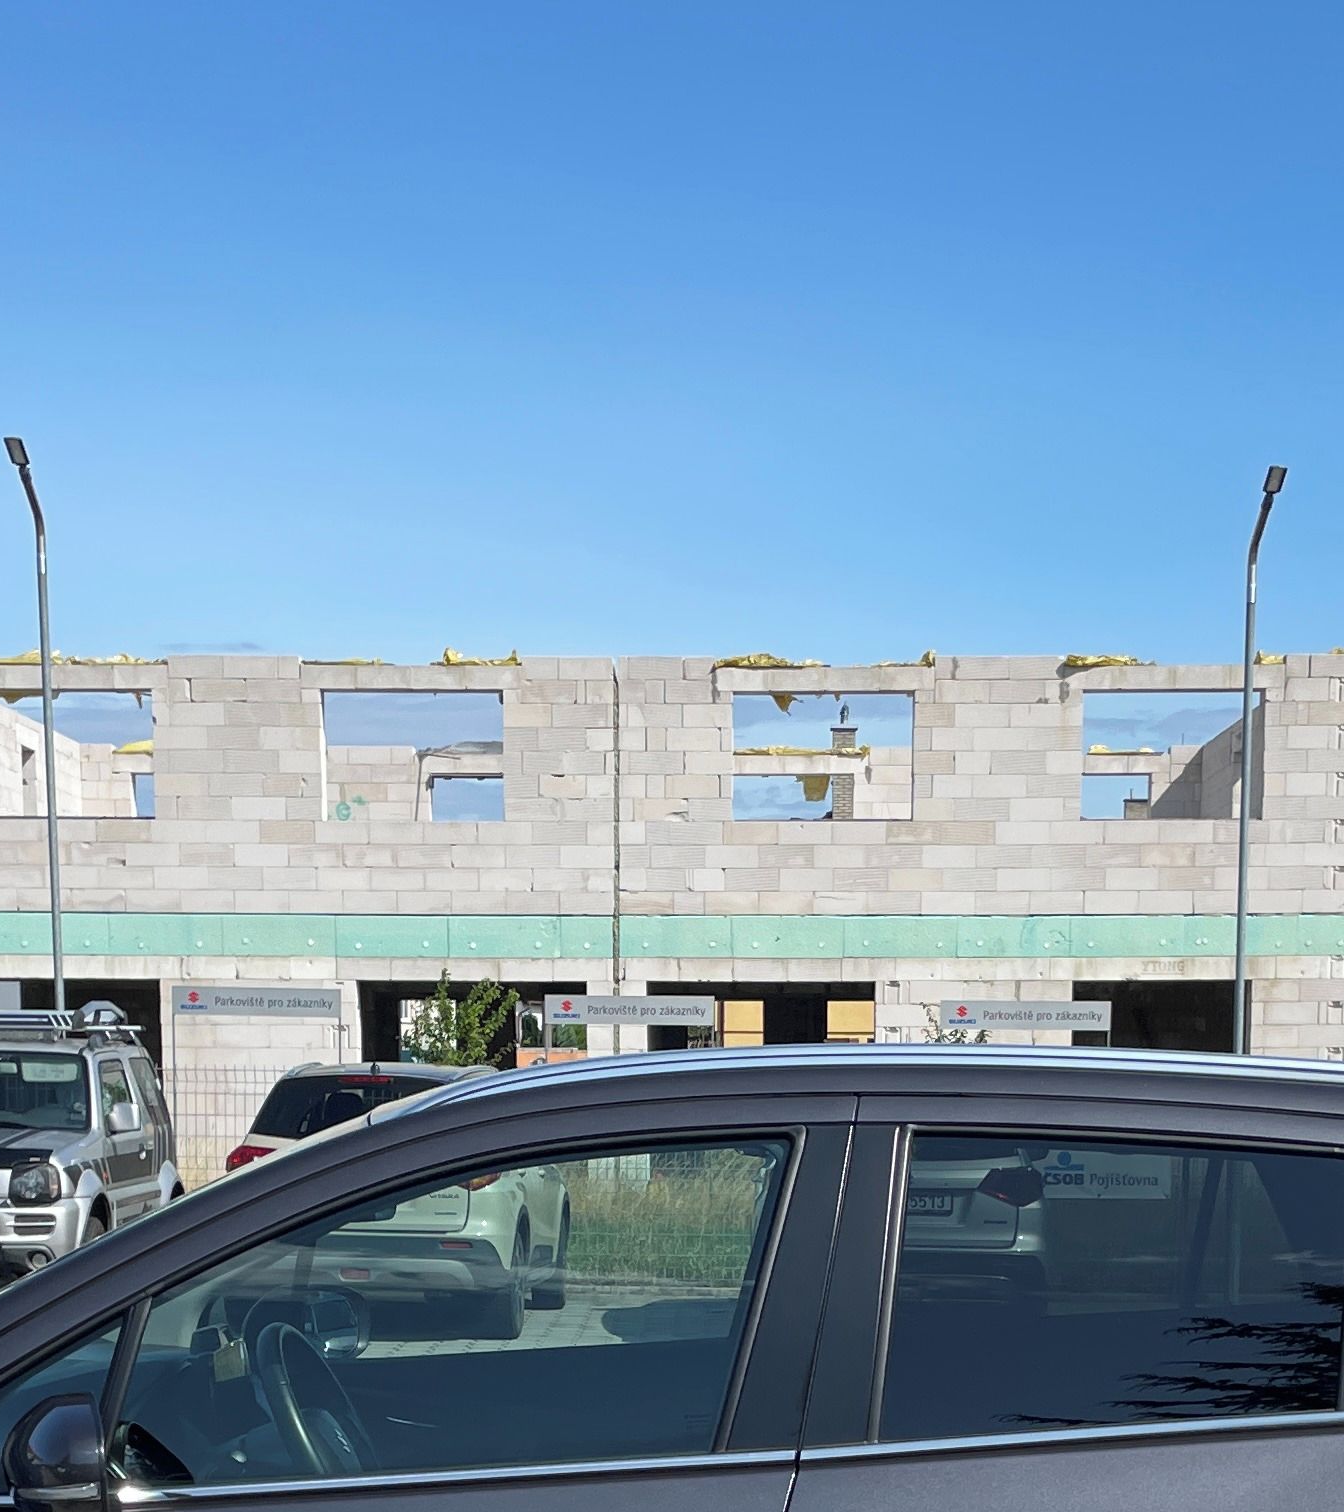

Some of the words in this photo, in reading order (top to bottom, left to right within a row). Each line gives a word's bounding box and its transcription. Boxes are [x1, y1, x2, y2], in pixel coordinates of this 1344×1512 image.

[214, 995, 264, 1007] Parkoviště
[268, 1000, 284, 1008] pro
[287, 997, 333, 1010] zákazníky
[587, 1004, 638, 1016] Parkoviště
[640, 1008, 656, 1017] pro
[660, 1005, 706, 1018] zákazníky
[983, 1009, 1033, 1021] Parkoviště
[1036, 1013, 1052, 1023] pro
[1056, 1010, 1103, 1022] zákazníky
[1090, 1173, 1158, 1189] Pojišťovna
